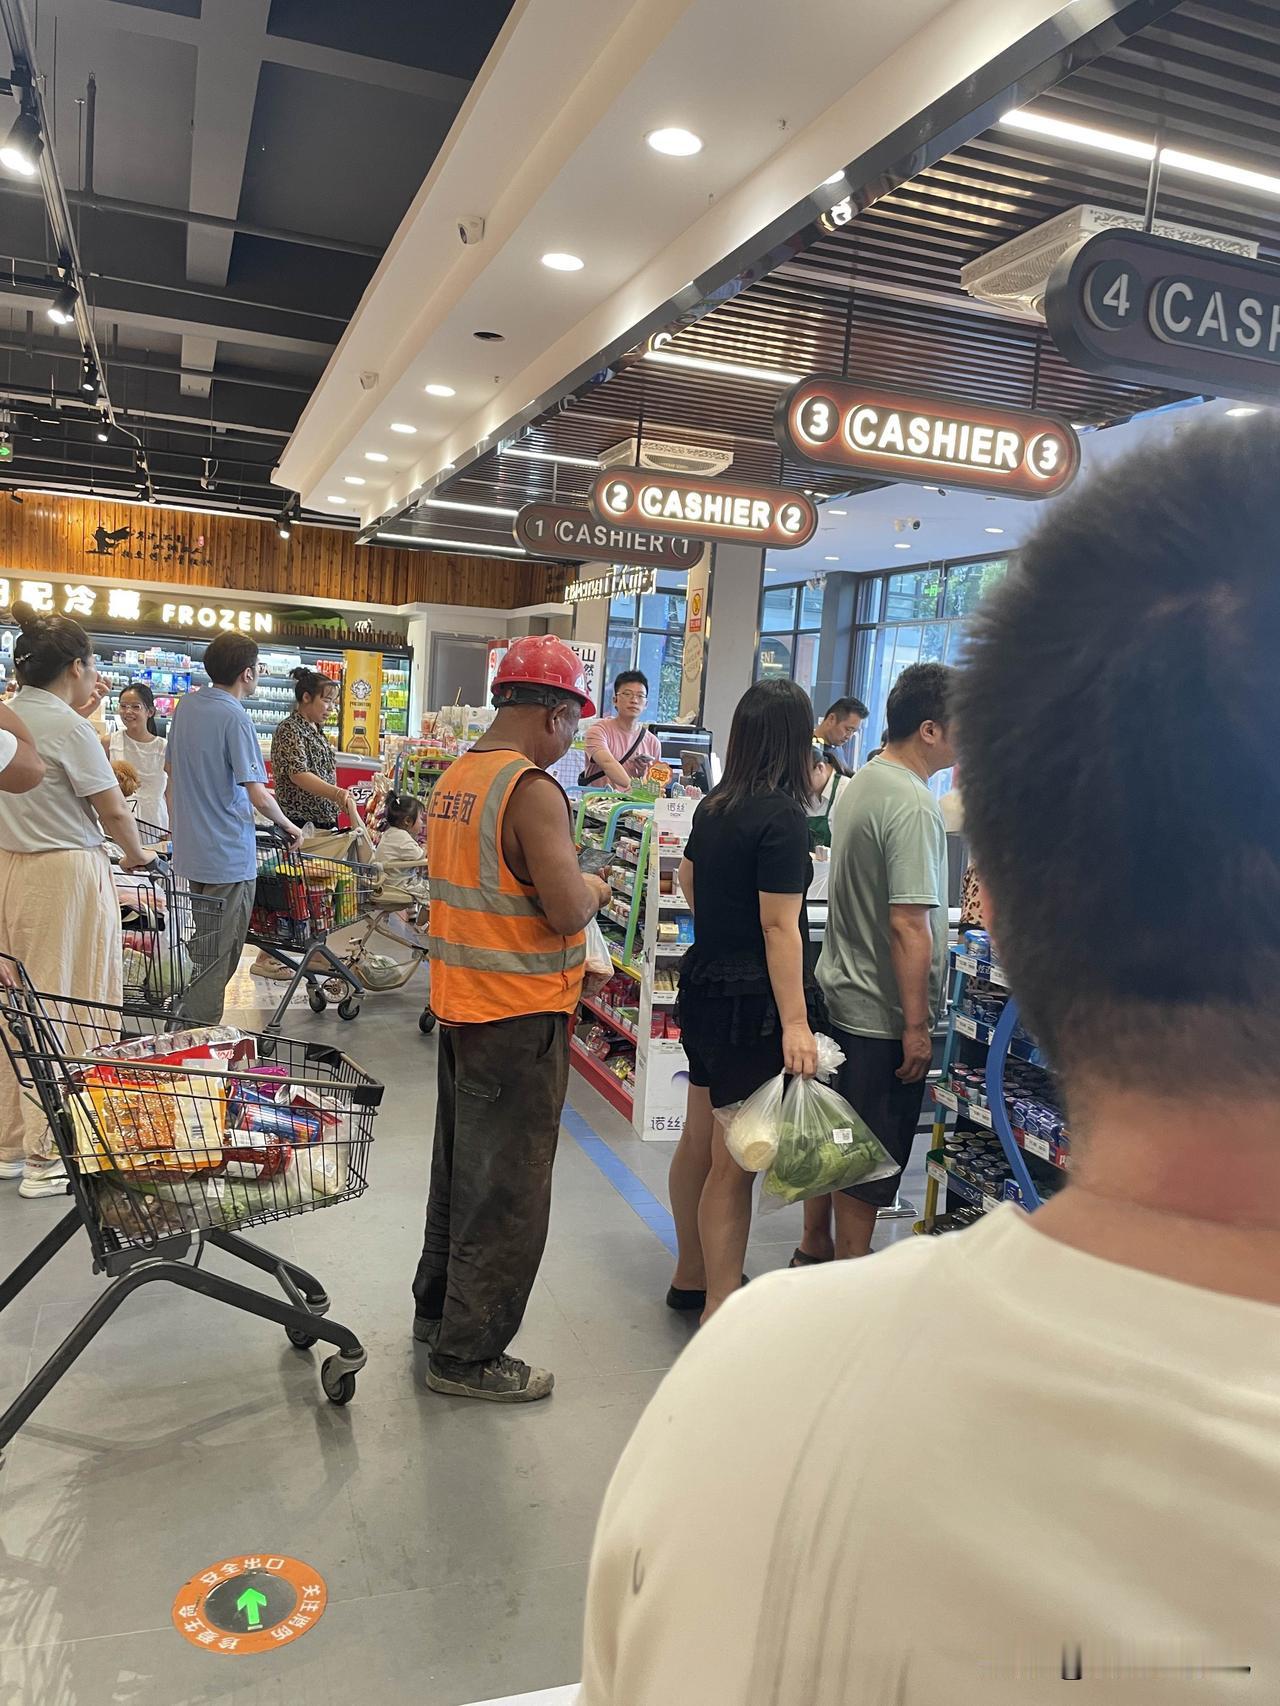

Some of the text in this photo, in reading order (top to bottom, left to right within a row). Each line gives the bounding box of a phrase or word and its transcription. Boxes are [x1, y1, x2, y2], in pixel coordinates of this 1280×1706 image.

[1102, 273, 1130, 317] 4
[808, 402, 1060, 472] 3 CASHIER 3
[610, 484, 801, 531] 2 CASHIER 2
[534, 518, 690, 554] 1 CASHIER 1
[162, 603, 274, 634] FROZEN
[651, 1116, 681, 1131] 诺丝
[200, 1557, 285, 1586] 安全出口
[178, 1602, 241, 1650] 珍爱生命
[271, 1584, 321, 1641] 关注消防
